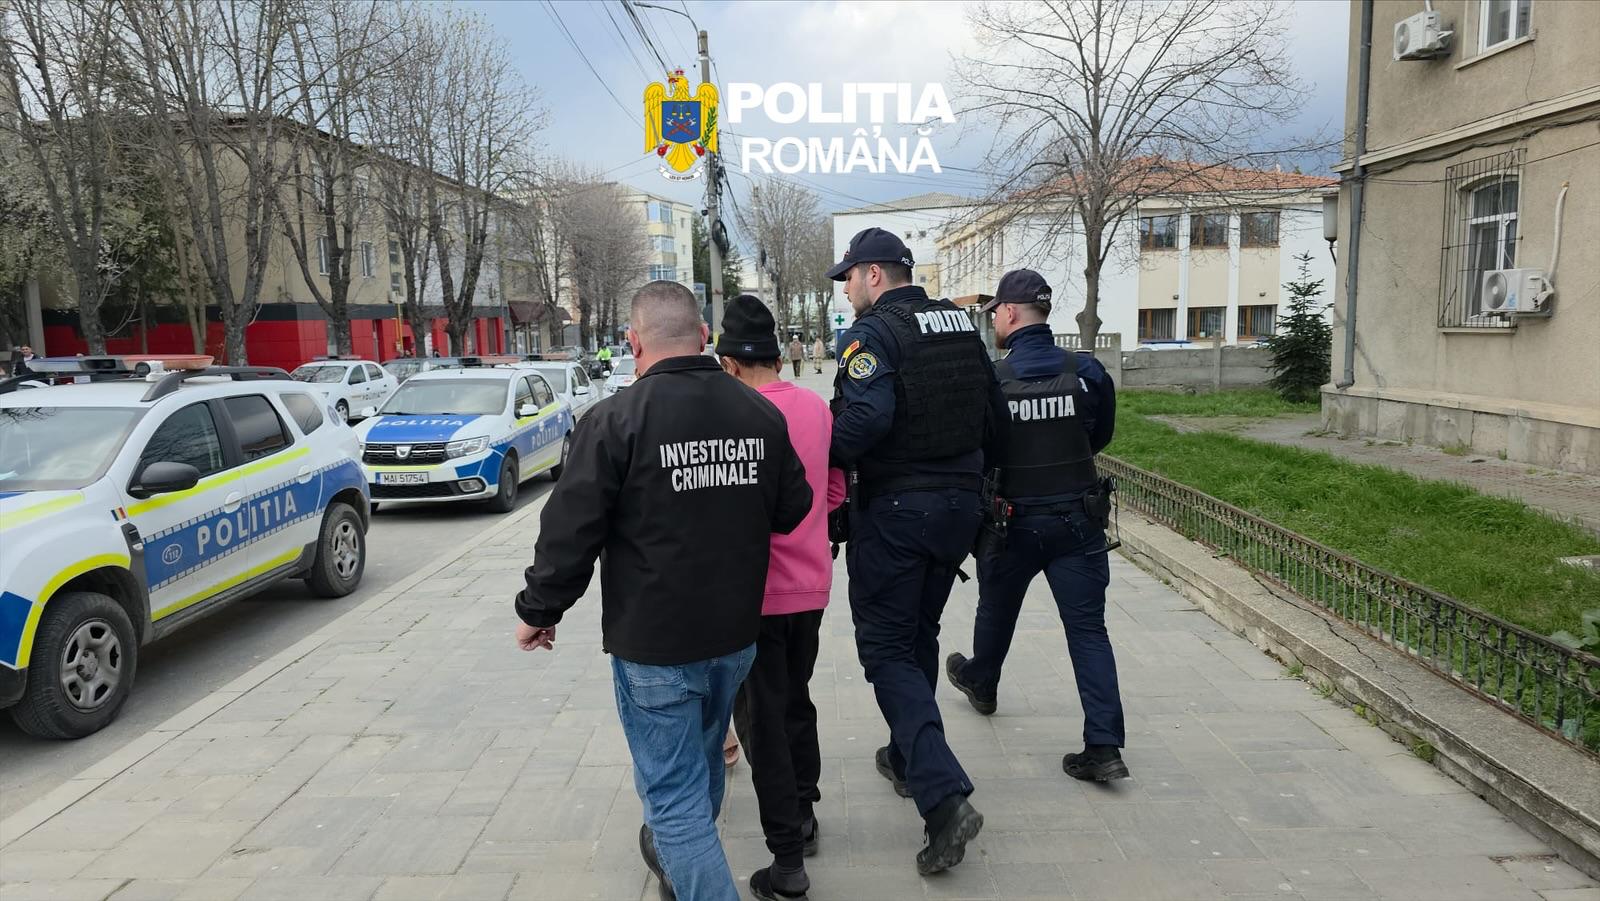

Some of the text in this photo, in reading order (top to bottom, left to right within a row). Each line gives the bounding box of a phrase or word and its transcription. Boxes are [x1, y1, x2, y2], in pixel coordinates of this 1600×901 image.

[914, 310, 975, 334] POLITIA
[1008, 395, 1076, 422] POLITIA
[660, 438, 765, 468] INVESTIGATII
[383, 474, 424, 483] MAI 51754
[671, 462, 758, 492] CRIMINALE
[197, 490, 297, 555] POLITIA
